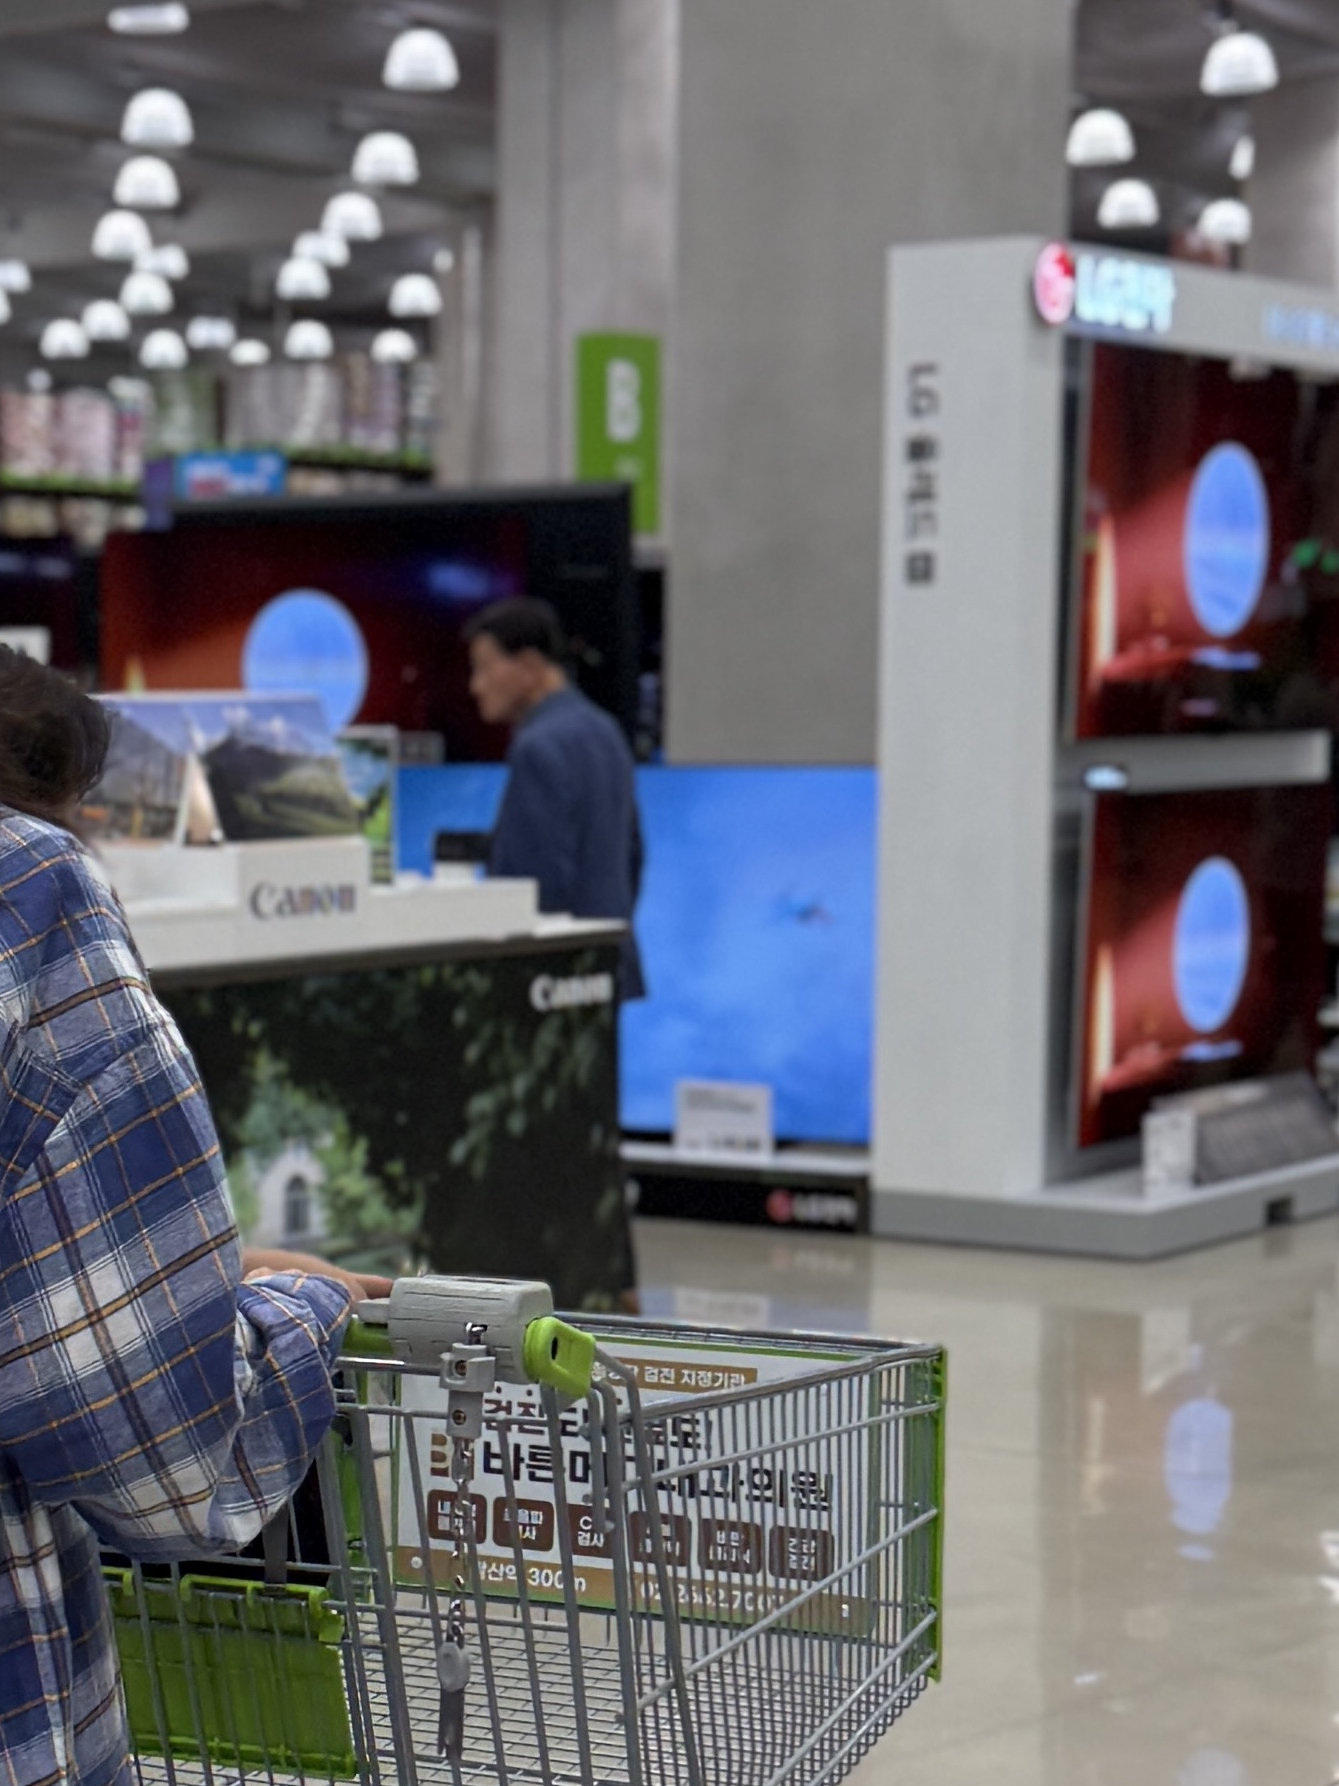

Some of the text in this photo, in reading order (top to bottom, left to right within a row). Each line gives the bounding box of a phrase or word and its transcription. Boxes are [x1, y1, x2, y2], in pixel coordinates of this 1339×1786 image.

[605, 357, 644, 442] B
[250, 881, 356, 920] Canon
[529, 972, 613, 1011] Canon
[644, 1366, 676, 1385] 검진
[681, 1369, 747, 1389] 지정기관
